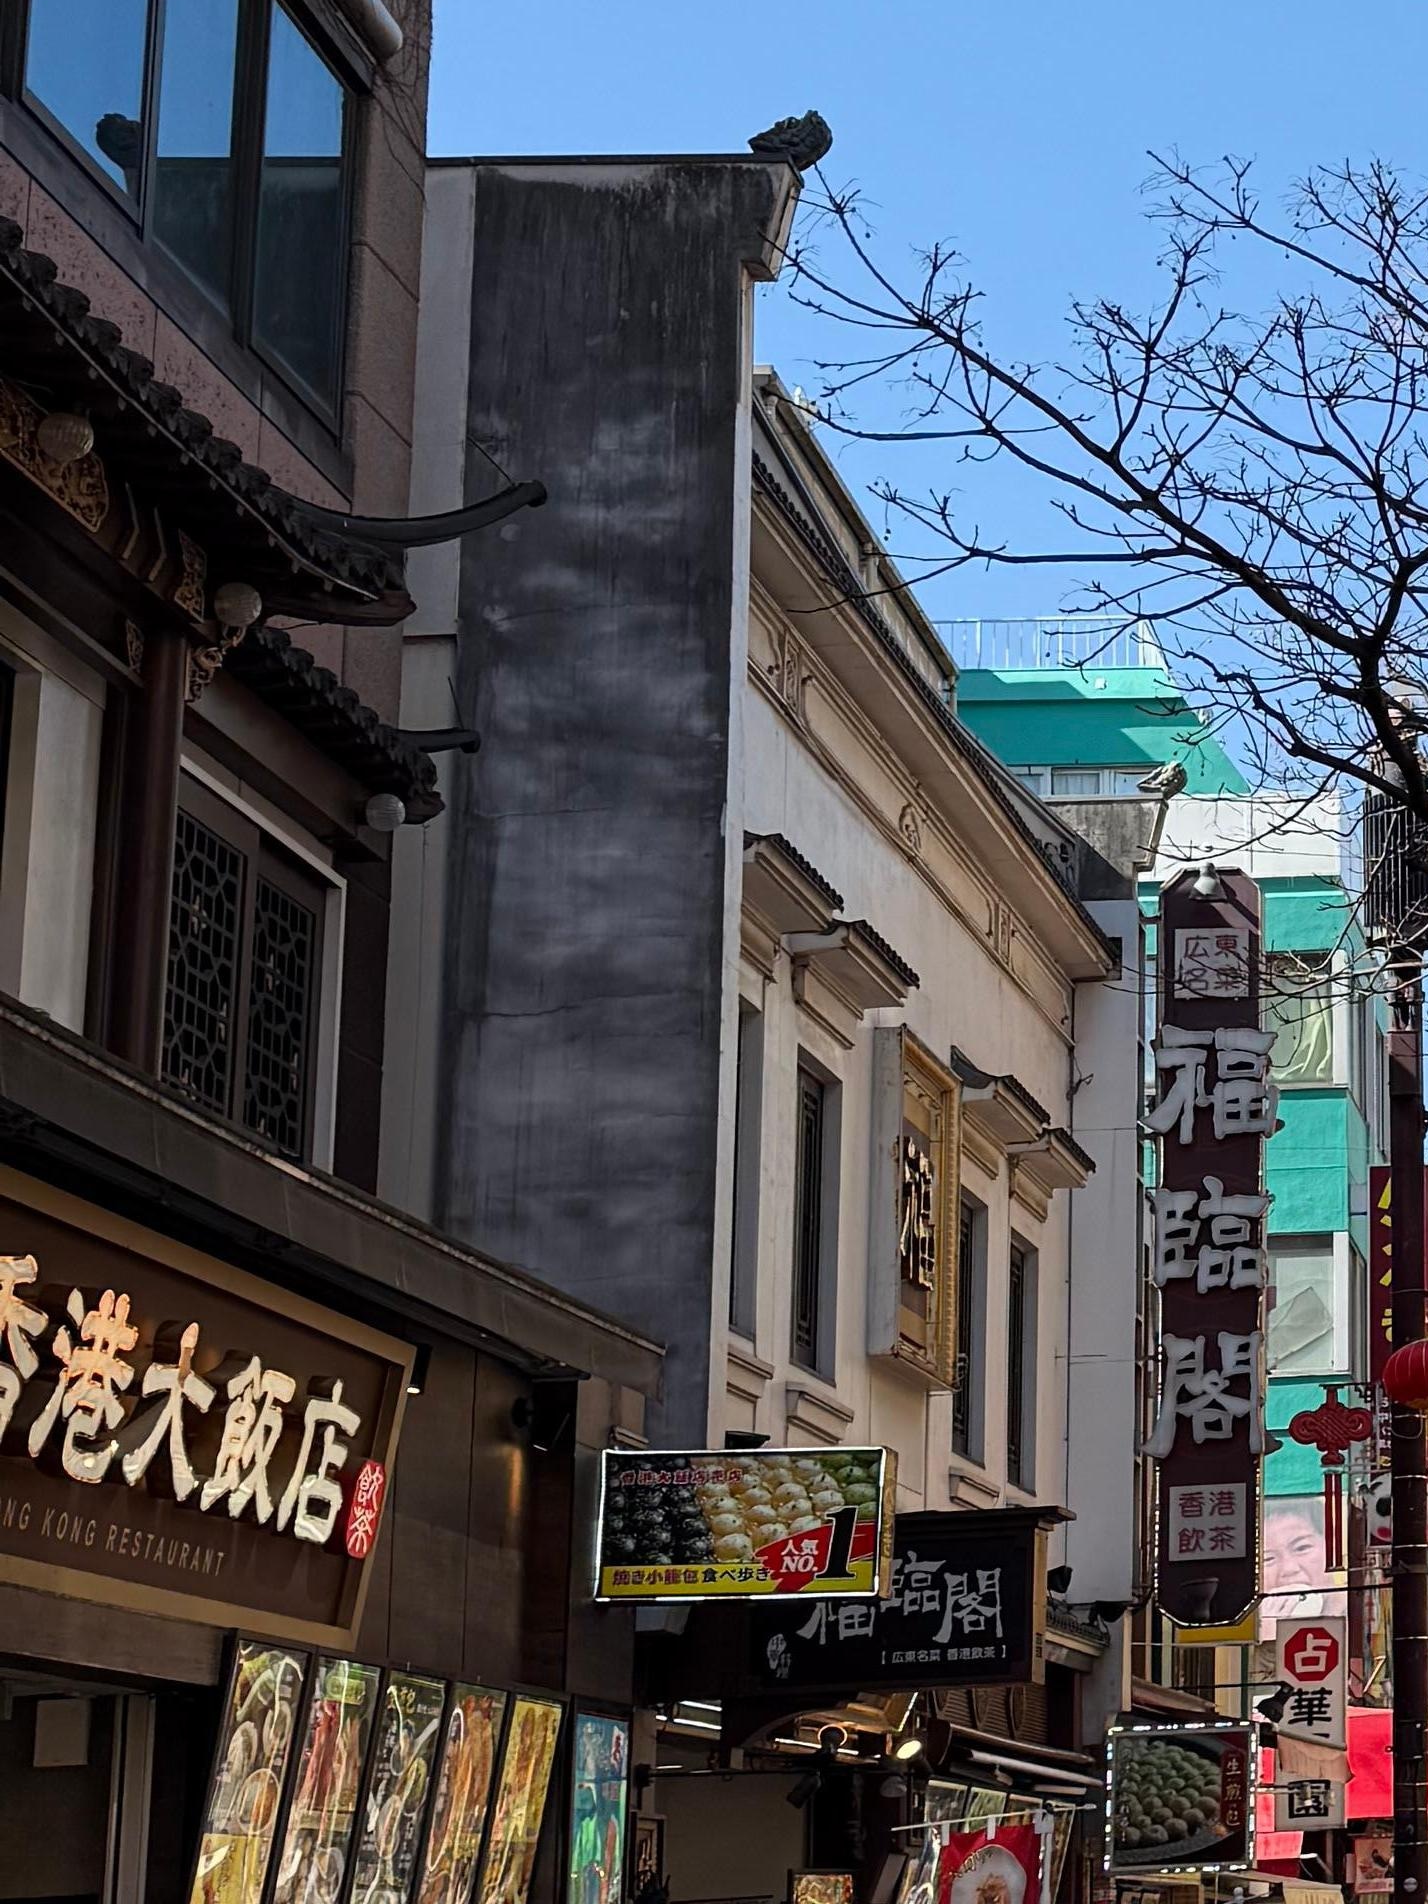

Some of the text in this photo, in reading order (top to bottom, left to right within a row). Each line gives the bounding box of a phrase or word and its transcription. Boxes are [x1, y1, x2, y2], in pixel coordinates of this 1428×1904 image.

[1141, 1025, 1280, 1459] 福臨閣
[349, 1462, 384, 1554] 飲茶
[1178, 1491, 1237, 1519] 香港
[42, 1508, 97, 1548] KONG
[105, 1524, 226, 1578] RESTAURANT
[780, 1538, 820, 1556] 人気
[1177, 1524, 1238, 1554] 飲茶
[701, 1566, 773, 1585] 食べ歩き
[891, 1646, 997, 1664] 広東名菜 香港飲茶
[1292, 1633, 1333, 1673] 占
[1287, 1687, 1333, 1819] 華園
